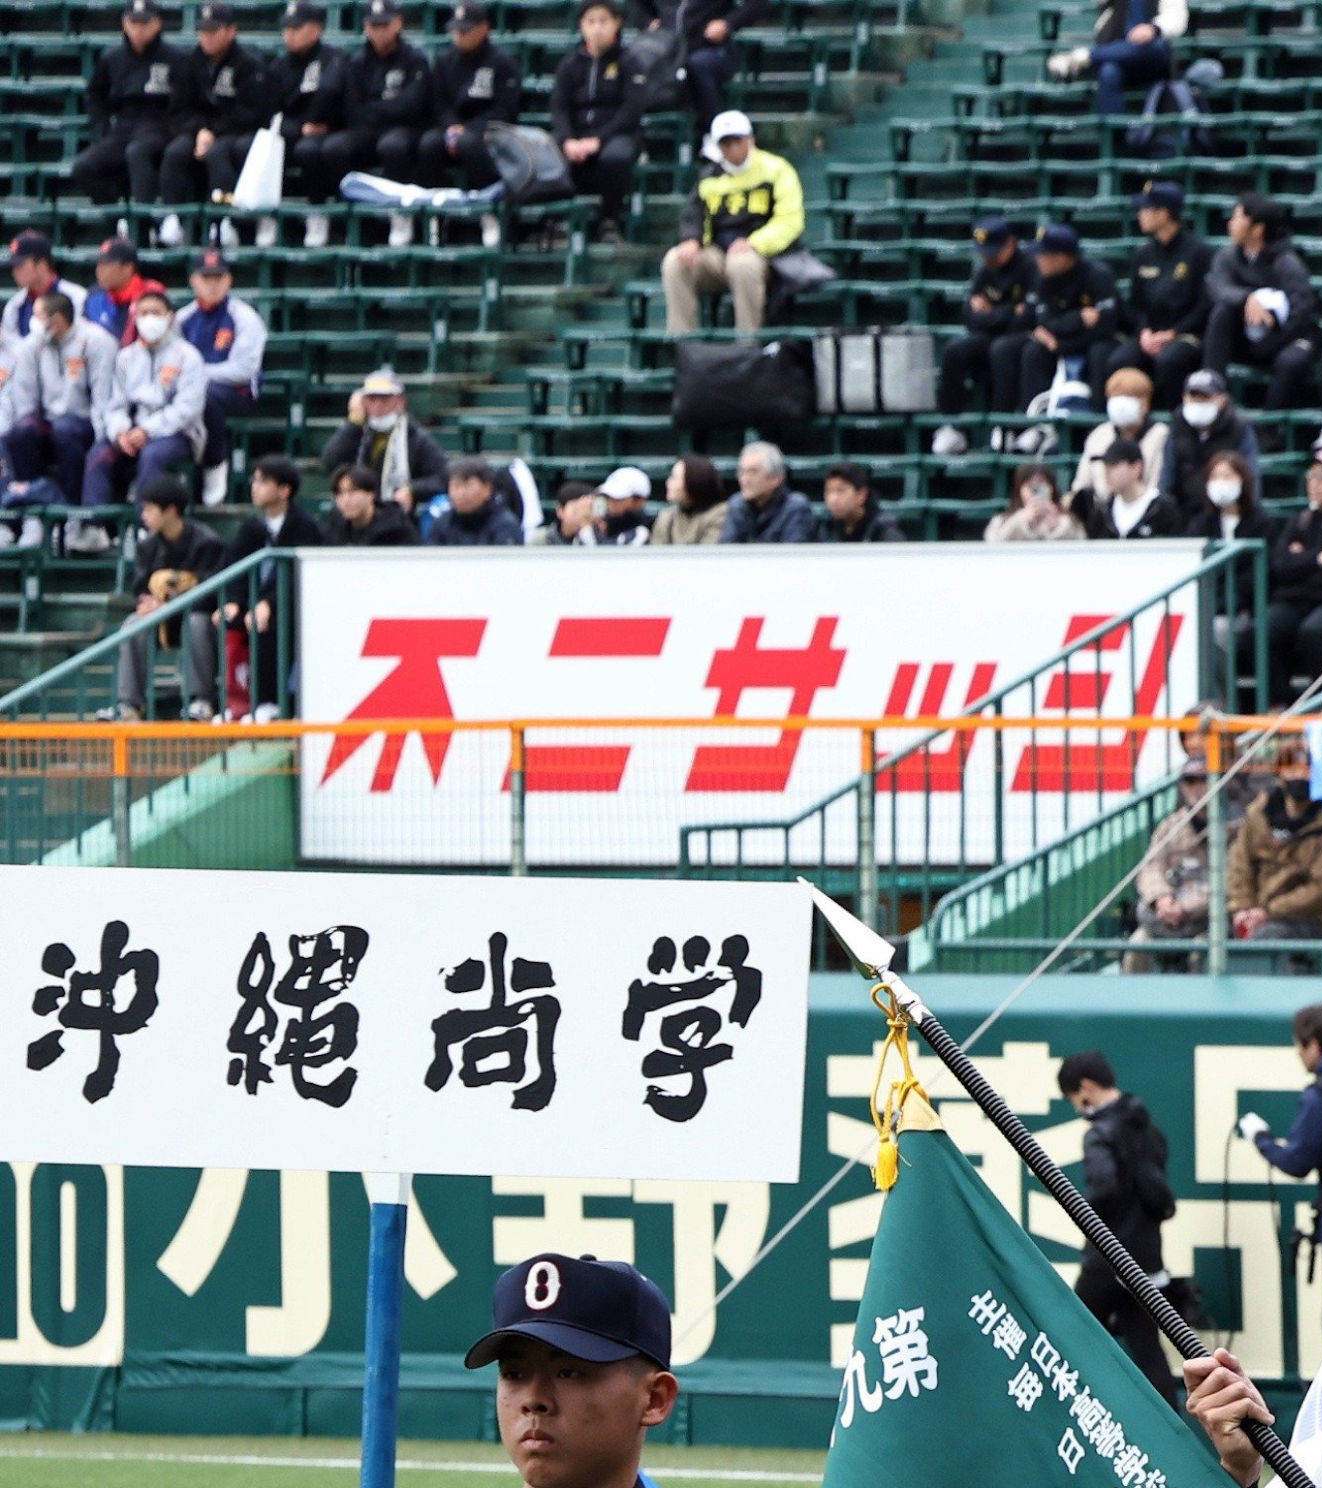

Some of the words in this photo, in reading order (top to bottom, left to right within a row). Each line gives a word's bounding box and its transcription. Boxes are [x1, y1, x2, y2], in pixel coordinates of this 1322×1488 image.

[318, 613, 1182, 792] 不二サッシ
[26, 919, 762, 1122] 沖縄尚学
[968, 1290, 1027, 1360] 主催
